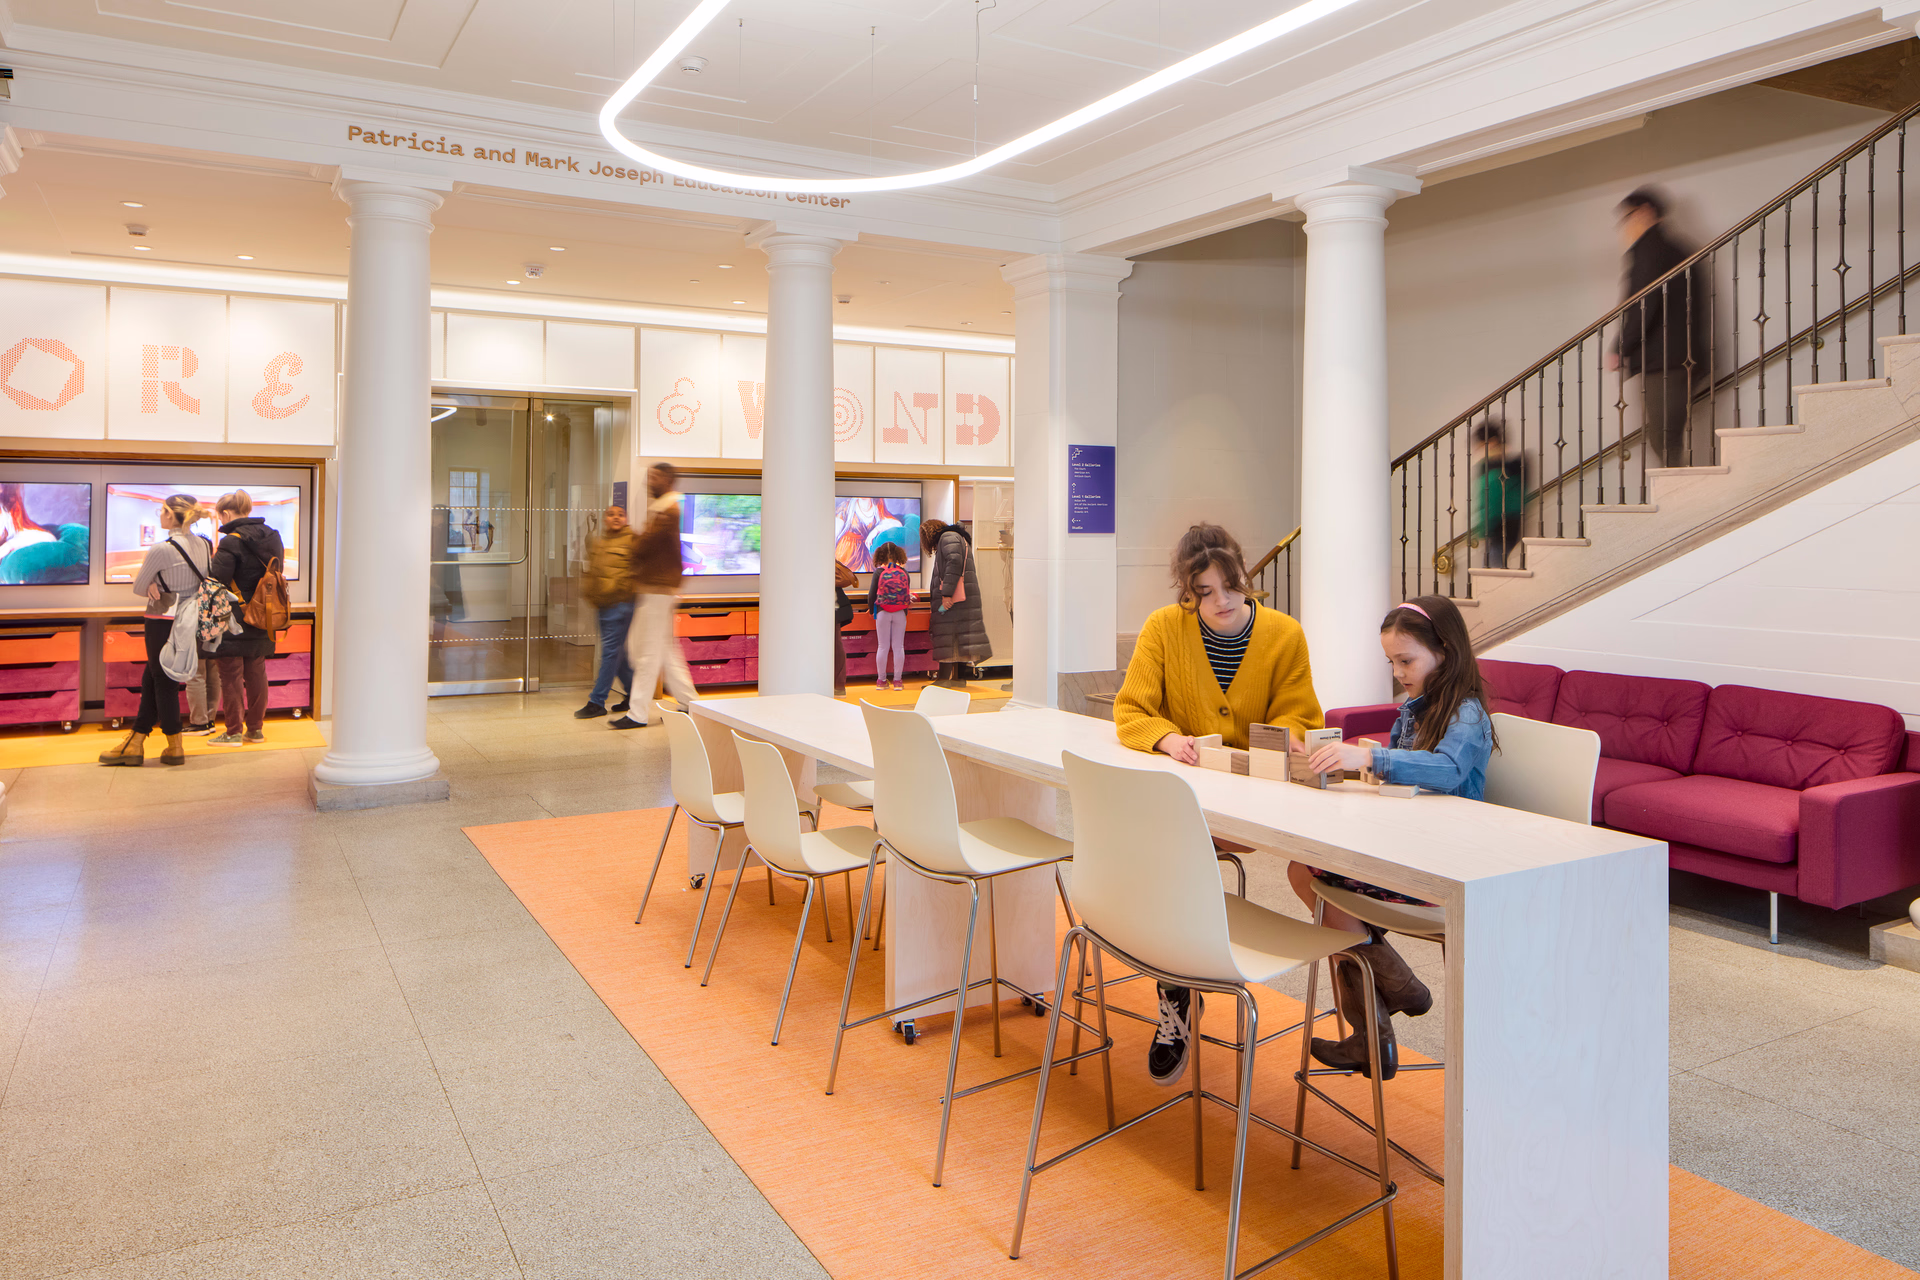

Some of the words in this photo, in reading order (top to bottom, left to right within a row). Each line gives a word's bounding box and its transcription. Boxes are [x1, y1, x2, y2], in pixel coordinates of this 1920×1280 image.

[348, 125, 465, 157] Patricia
[473, 148, 516, 164] and
[525, 150, 581, 173] Mark
[589, 161, 664, 186] Joseph
[785, 191, 851, 209] Center
